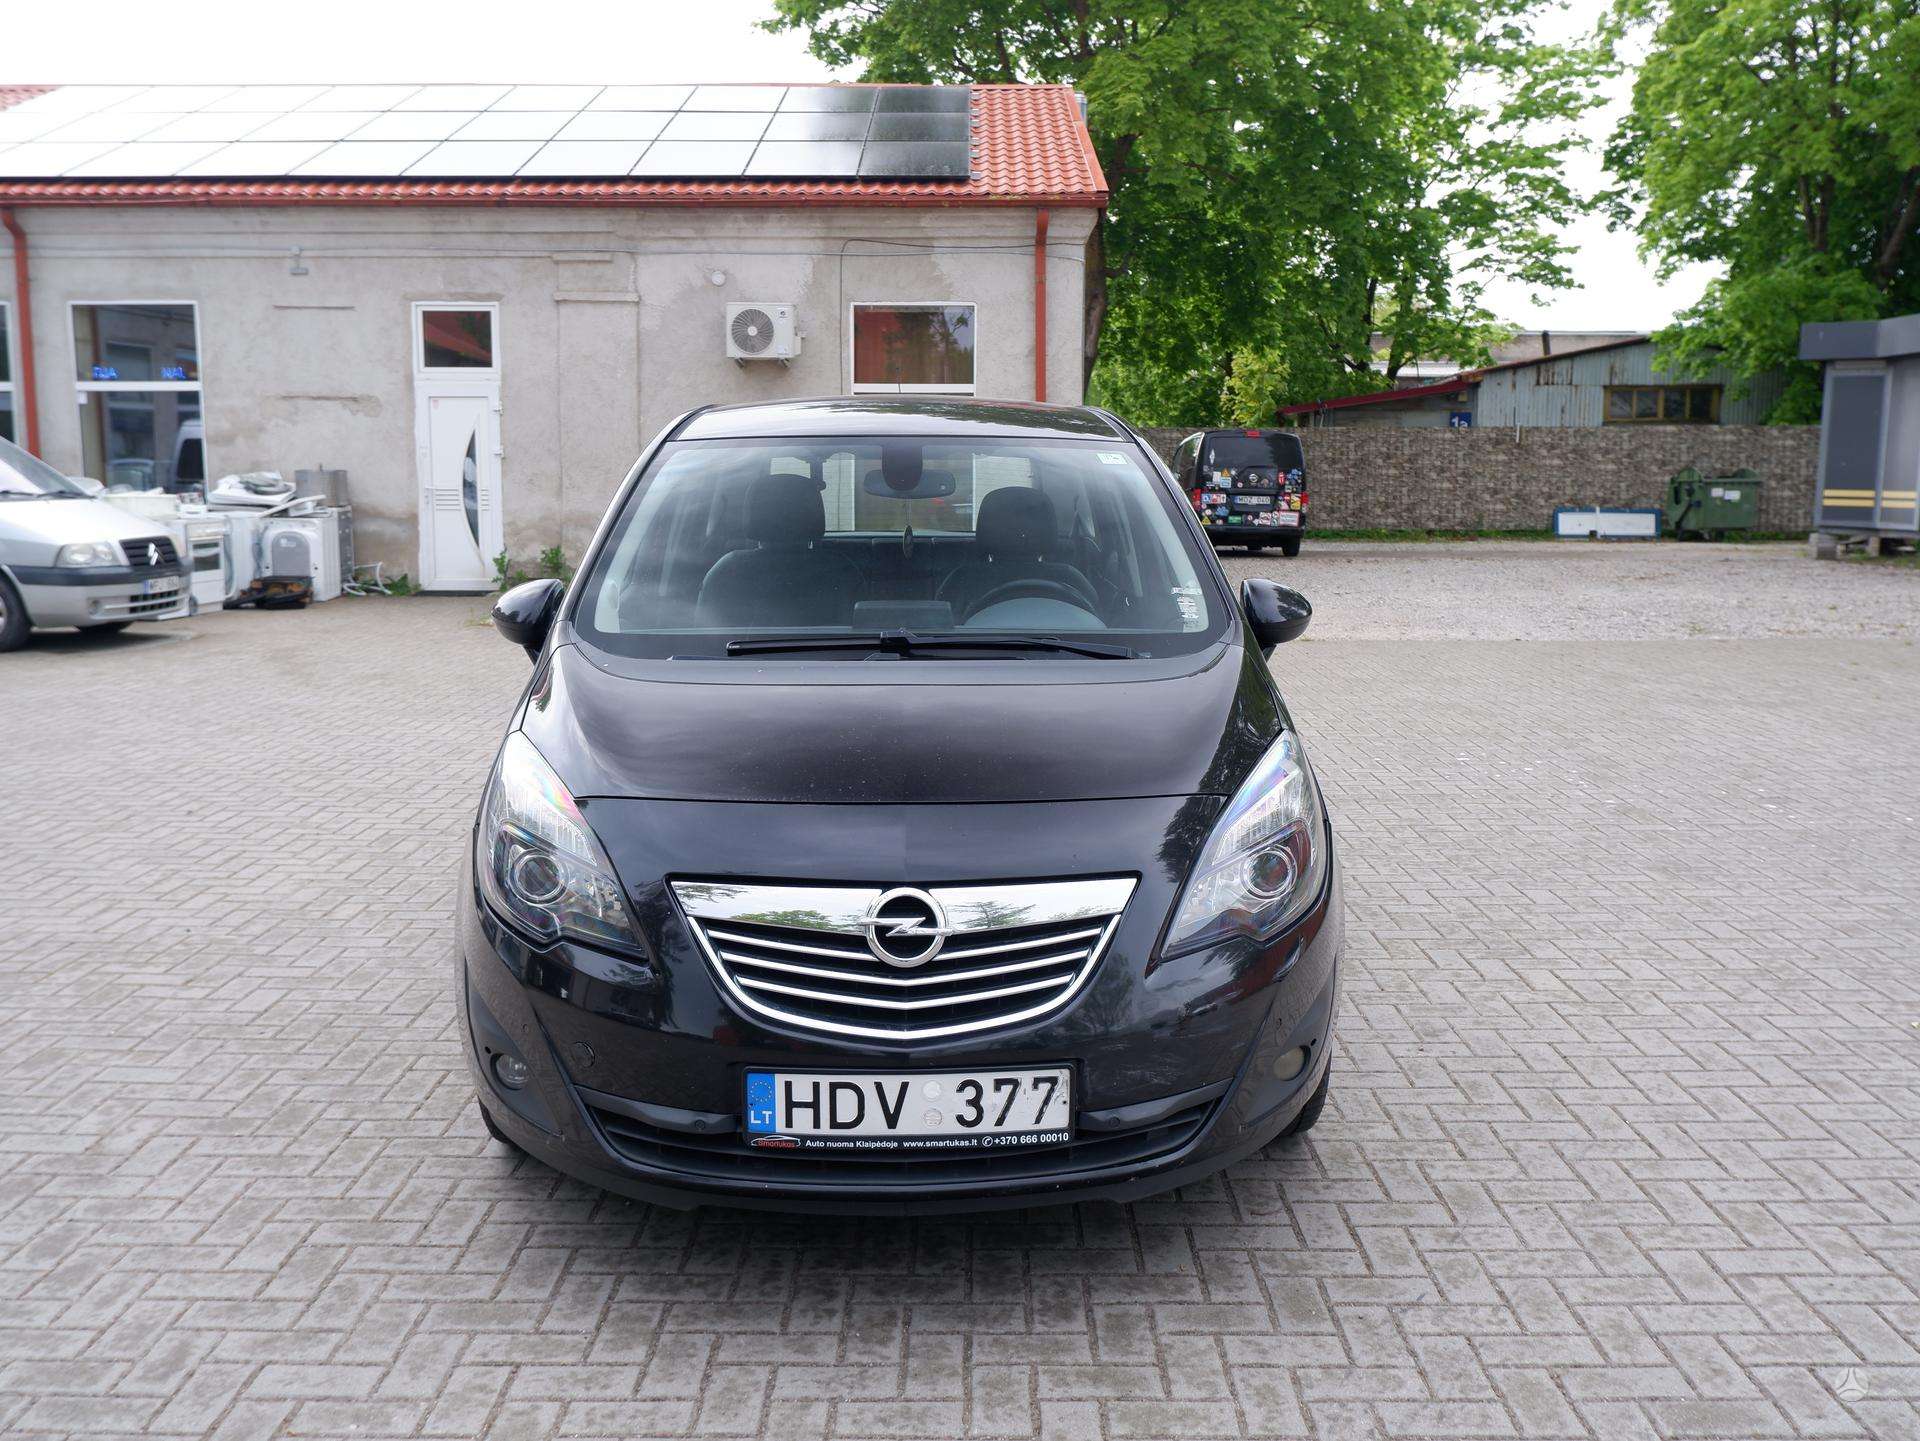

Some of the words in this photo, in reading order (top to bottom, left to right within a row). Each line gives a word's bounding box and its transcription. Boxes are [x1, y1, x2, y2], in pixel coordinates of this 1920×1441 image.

[784, 1080, 910, 1130] HDV
[955, 1076, 1061, 1128] 377
[751, 1110, 772, 1125] LT
[757, 1139, 796, 1149] Smartukas
[805, 1139, 825, 1148] Auto
[827, 1140, 854, 1148] nuoma
[856, 1139, 898, 1150] Klaipėdoje
[903, 1137, 978, 1148] www.smartukas.lt
[994, 1136, 1018, 1146] +370
[1020, 1135, 1038, 1144] 666
[1040, 1132, 1069, 1143] 00010
